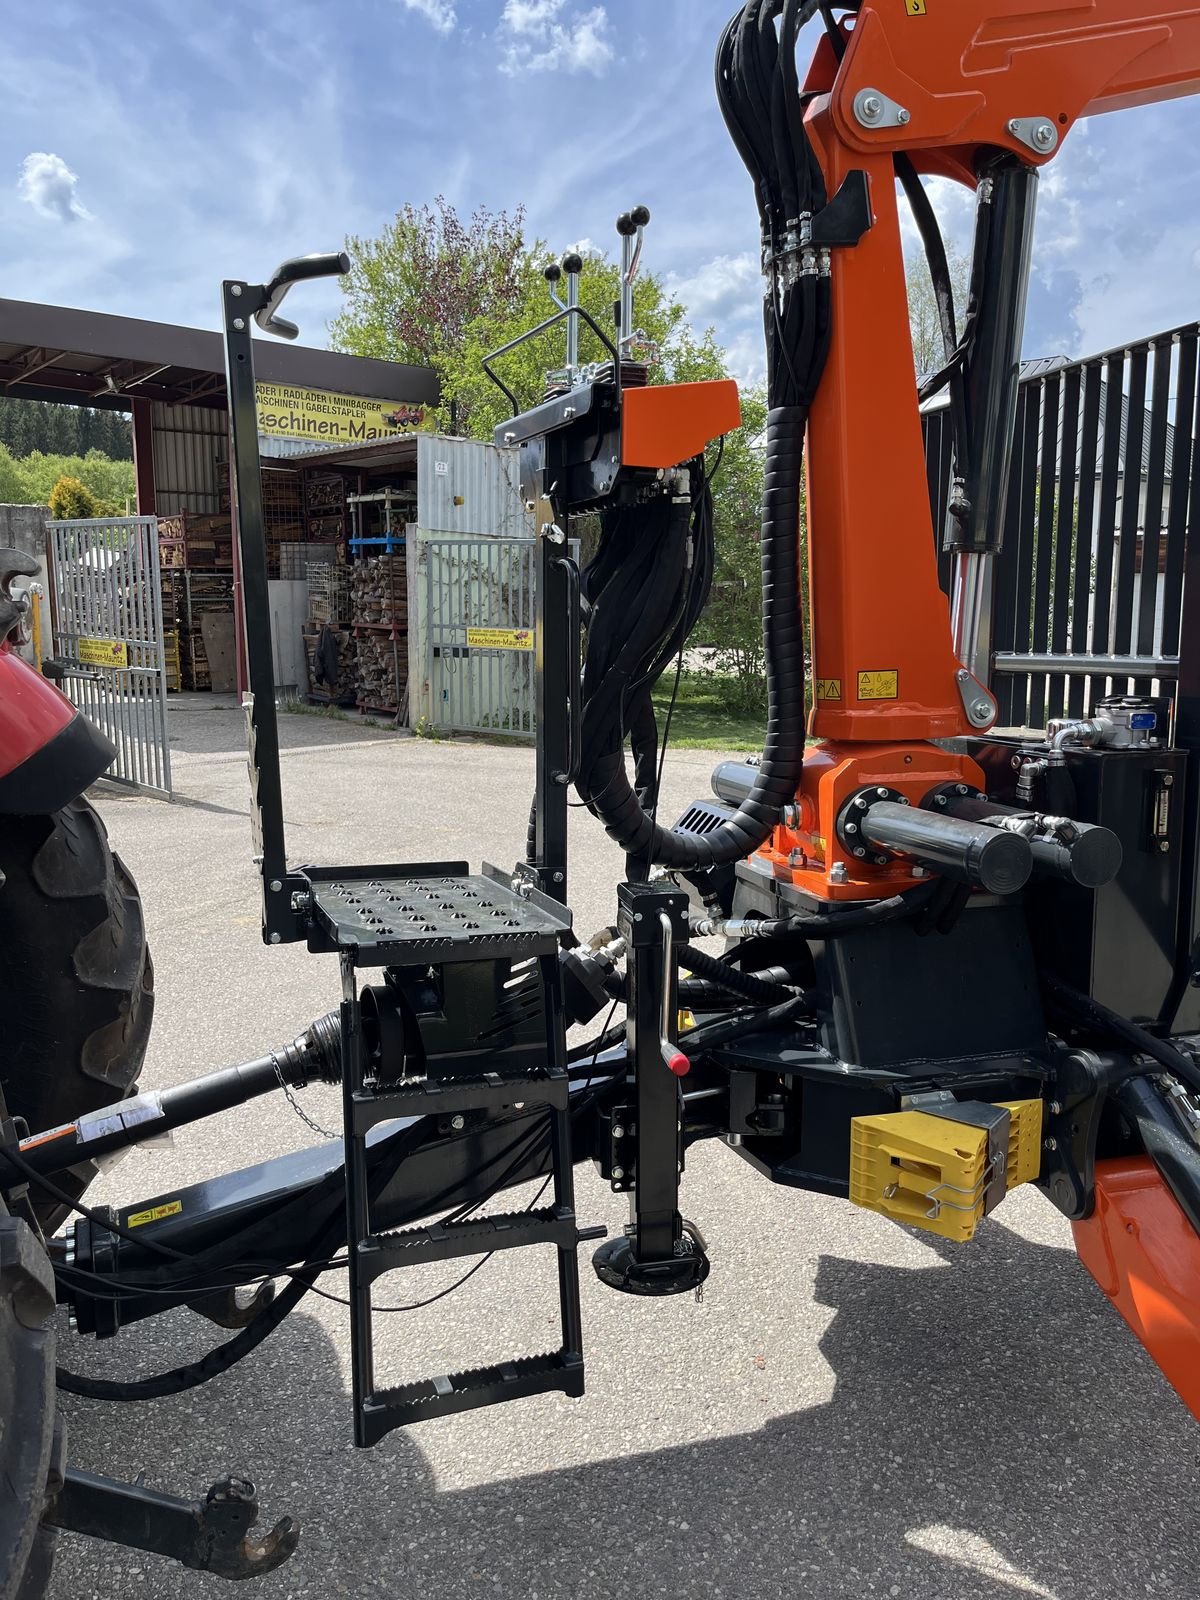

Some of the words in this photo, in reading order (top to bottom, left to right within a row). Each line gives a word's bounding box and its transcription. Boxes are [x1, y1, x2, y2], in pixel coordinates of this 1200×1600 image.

[255, 385, 276, 397] ADER
[284, 389, 327, 403] RADLADER
[334, 396, 382, 412] MINIBAGGER
[306, 402, 366, 418] GABELSTAPLER
